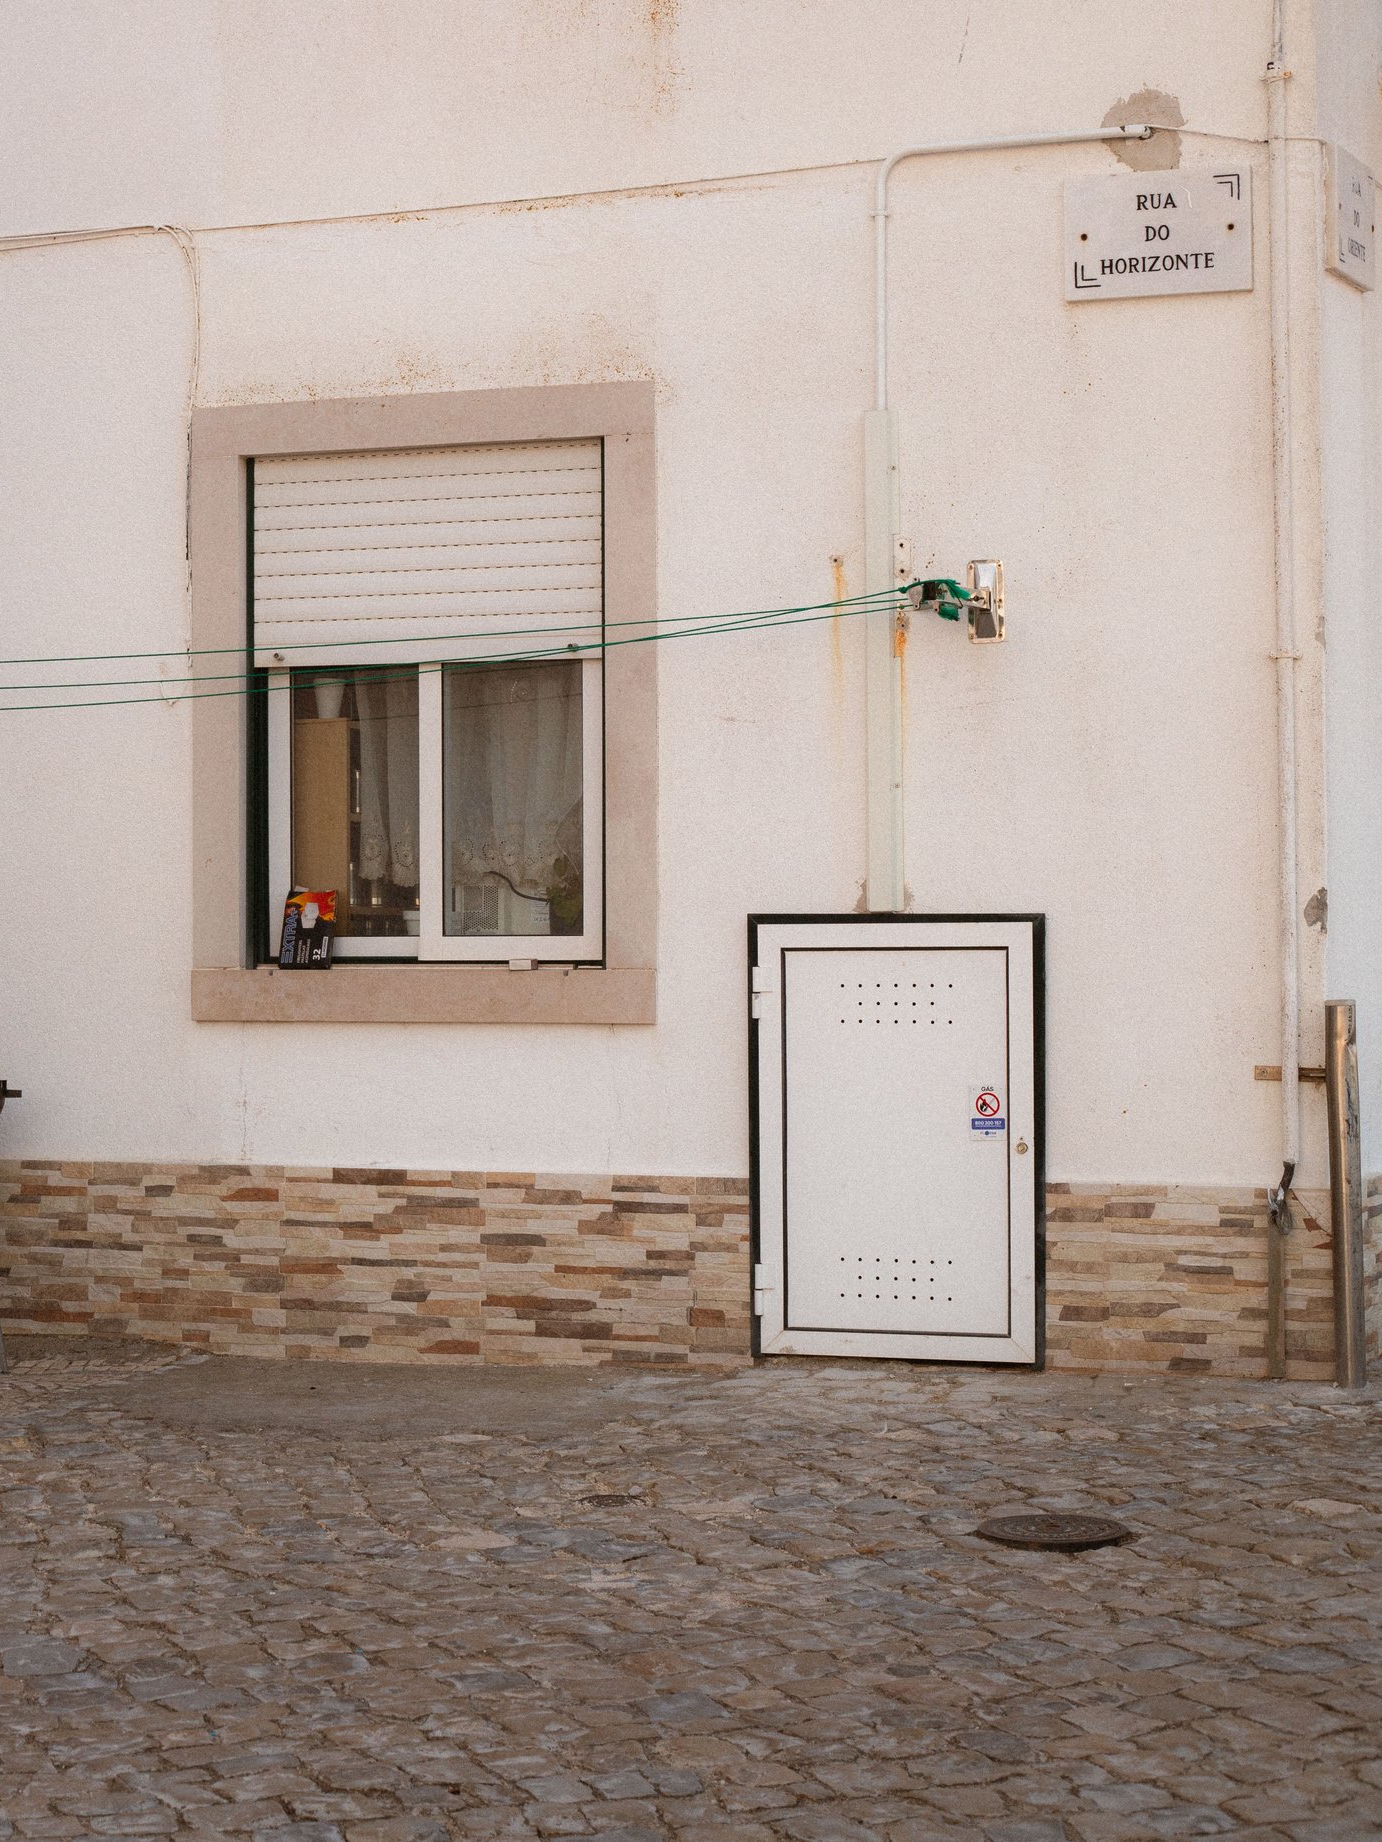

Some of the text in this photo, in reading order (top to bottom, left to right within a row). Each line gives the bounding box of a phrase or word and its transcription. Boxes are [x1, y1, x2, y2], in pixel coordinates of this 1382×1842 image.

[1136, 192, 1177, 210] RUA
[1144, 224, 1170, 241] DO
[1100, 252, 1215, 275] HORIZONTE
[312, 949, 321, 960] 32
